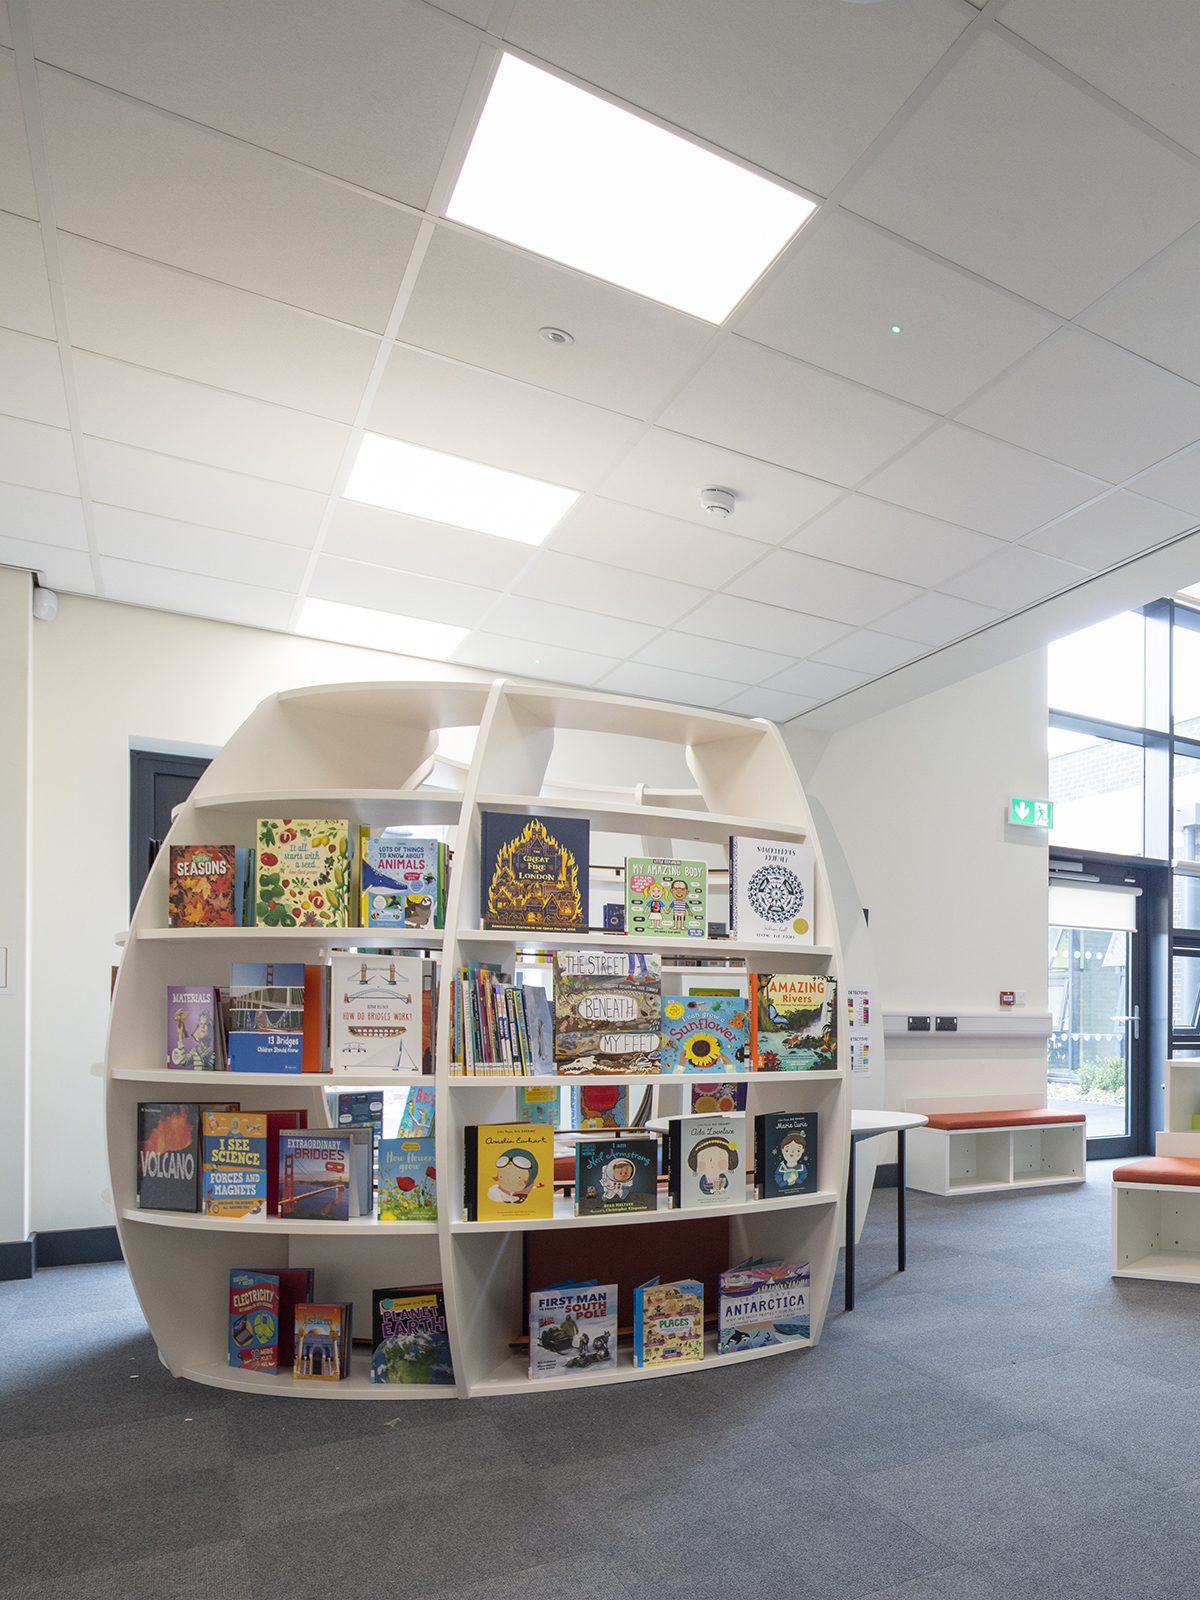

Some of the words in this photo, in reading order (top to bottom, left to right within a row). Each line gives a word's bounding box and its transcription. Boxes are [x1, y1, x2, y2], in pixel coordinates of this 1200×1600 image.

[298, 843, 308, 852] all
[304, 851, 320, 860] with
[523, 855, 550, 863] GREAT
[177, 861, 227, 876] SEASONS
[377, 859, 426, 870] ANIMALS
[527, 863, 546, 871] FIRE
[632, 864, 644, 874] MY
[647, 865, 681, 876] AMAZING
[685, 866, 703, 877] BODY
[518, 872, 555, 881] LONDON
[565, 956, 585, 974] THE
[588, 955, 626, 976] STREET
[769, 981, 824, 994] AMAZING
[172, 993, 211, 1003] MATERIALS
[782, 995, 812, 1003] Rivers
[585, 997, 634, 1018] BENEATH
[342, 1012, 355, 1020] HOW
[357, 1012, 365, 1020] DO
[367, 1012, 390, 1021] BRIDGES
[393, 1012, 412, 1021] WORK?
[702, 1012, 720, 1020] grow
[669, 1018, 737, 1042] Sunflower
[267, 1036, 275, 1045] 13
[276, 1036, 299, 1049] Bridges
[604, 1035, 620, 1052] MY
[624, 1035, 654, 1052] FEET
[691, 1128, 706, 1136] Ada
[220, 1139, 226, 1150] I
[228, 1138, 250, 1151] SEE
[287, 1138, 341, 1150] EXTRAORDINARY
[485, 1137, 514, 1145] Amelia
[516, 1136, 547, 1144] Earhart
[211, 1149, 260, 1166] SCIENCE
[294, 1148, 345, 1161] BRIDGES
[386, 1151, 404, 1162] How
[407, 1152, 436, 1162] flowers
[586, 1151, 604, 1169] Neil
[605, 1148, 650, 1166] Armstrong
[140, 1150, 195, 1180] VOLCANO
[399, 1164, 420, 1173] grow
[210, 1173, 244, 1183] FORCES
[245, 1174, 260, 1183] AND
[214, 1185, 257, 1196] MAGNETS
[233, 1289, 274, 1307] ELECTRICITY
[538, 1296, 573, 1308] FIRST
[576, 1292, 607, 1303] MAN
[740, 1295, 763, 1303] LET'S
[565, 1301, 607, 1313] SOUTH
[725, 1294, 805, 1317] ANTARCTICA
[382, 1305, 438, 1322] PLANET
[576, 1309, 607, 1320] POLE
[303, 1314, 333, 1326] Islam
[659, 1318, 689, 1328] PLACES
[382, 1316, 445, 1338] EARTH
[251, 1349, 260, 1360] 10
